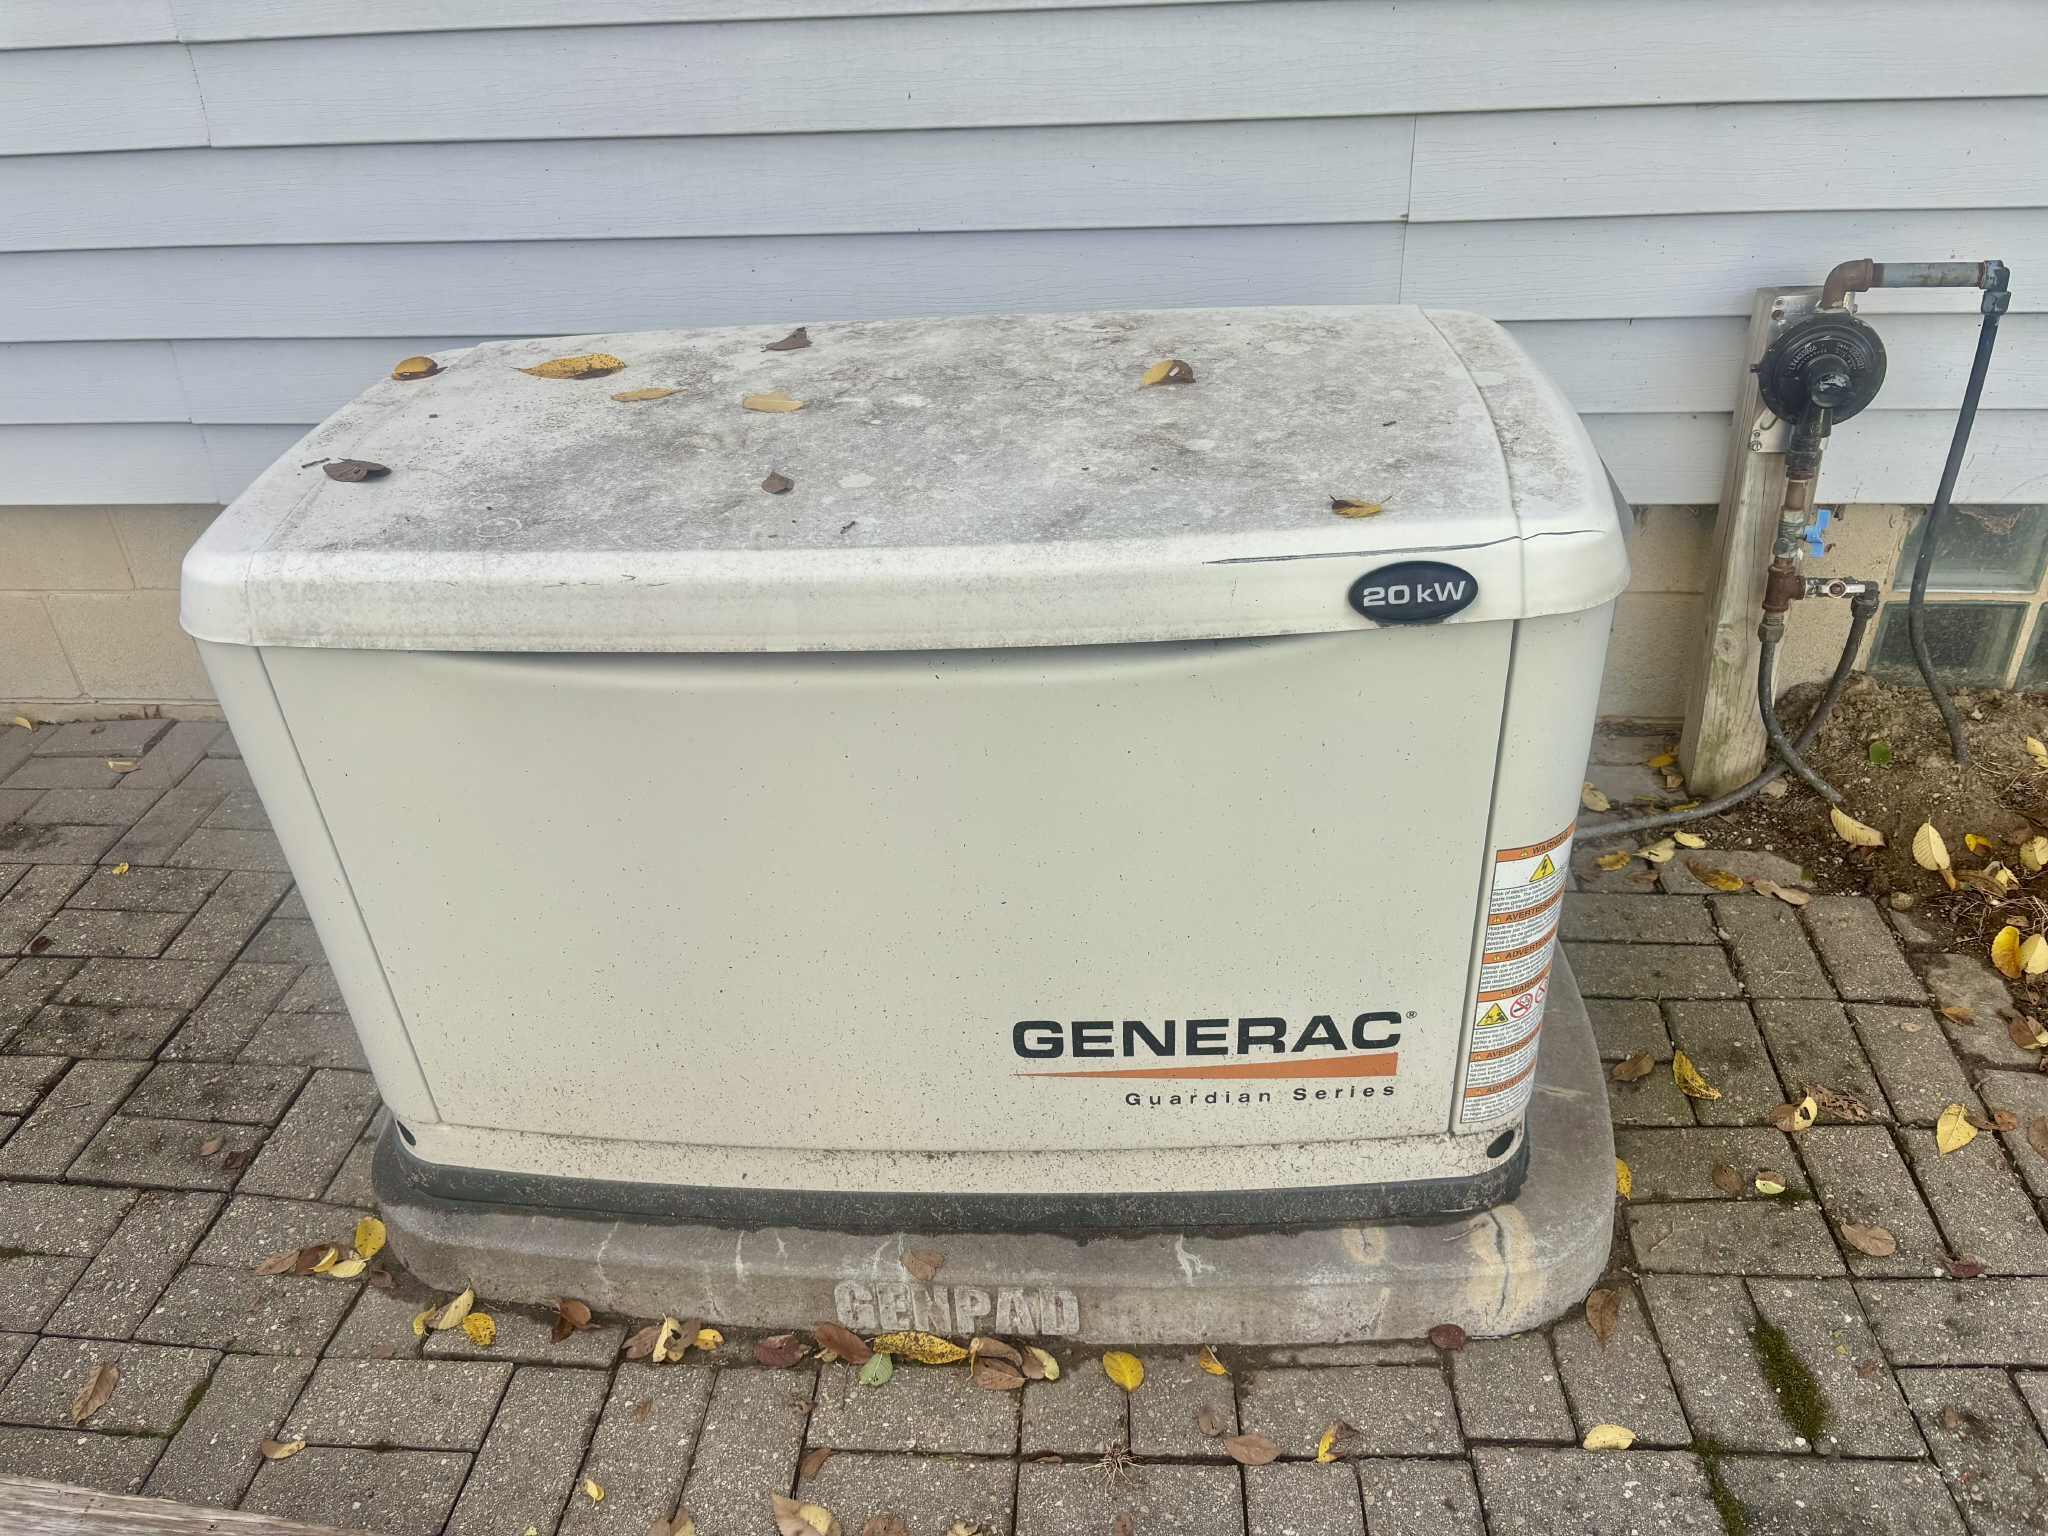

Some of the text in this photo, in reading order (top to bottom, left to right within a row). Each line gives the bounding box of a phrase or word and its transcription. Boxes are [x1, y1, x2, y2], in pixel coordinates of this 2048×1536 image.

[1363, 580, 1467, 607] 20 kW
[1012, 1011, 1402, 1058] GENERAC
[1125, 1083, 1395, 1106] Guardian Series
[834, 1280, 1079, 1335] GENPAD
